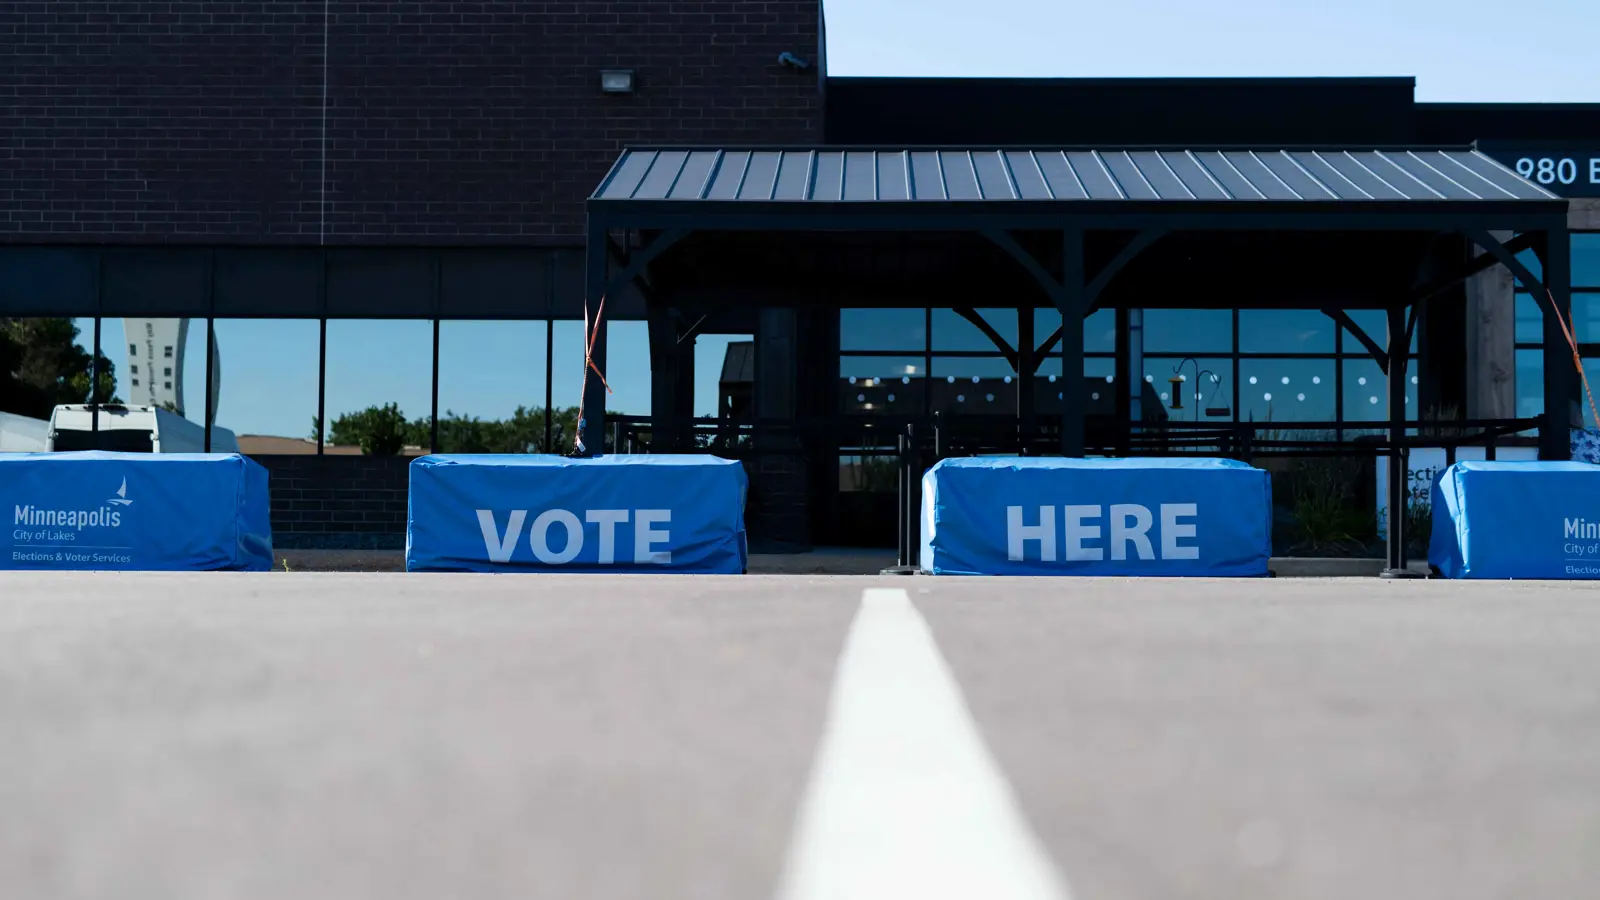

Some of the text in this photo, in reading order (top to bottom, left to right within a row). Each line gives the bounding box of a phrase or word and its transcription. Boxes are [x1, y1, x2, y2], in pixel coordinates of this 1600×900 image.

[1516, 157, 1577, 185] 980
[14, 504, 121, 531] Minneapolis
[1564, 517, 1600, 539] Min
[13, 529, 75, 543] City of Lakes
[475, 508, 672, 565] VOTE
[1006, 503, 1200, 562] HERE
[12, 551, 131, 563] Elections & Voter Services
[1564, 542, 1599, 556] City of
[1565, 565, 1600, 574] Electio
